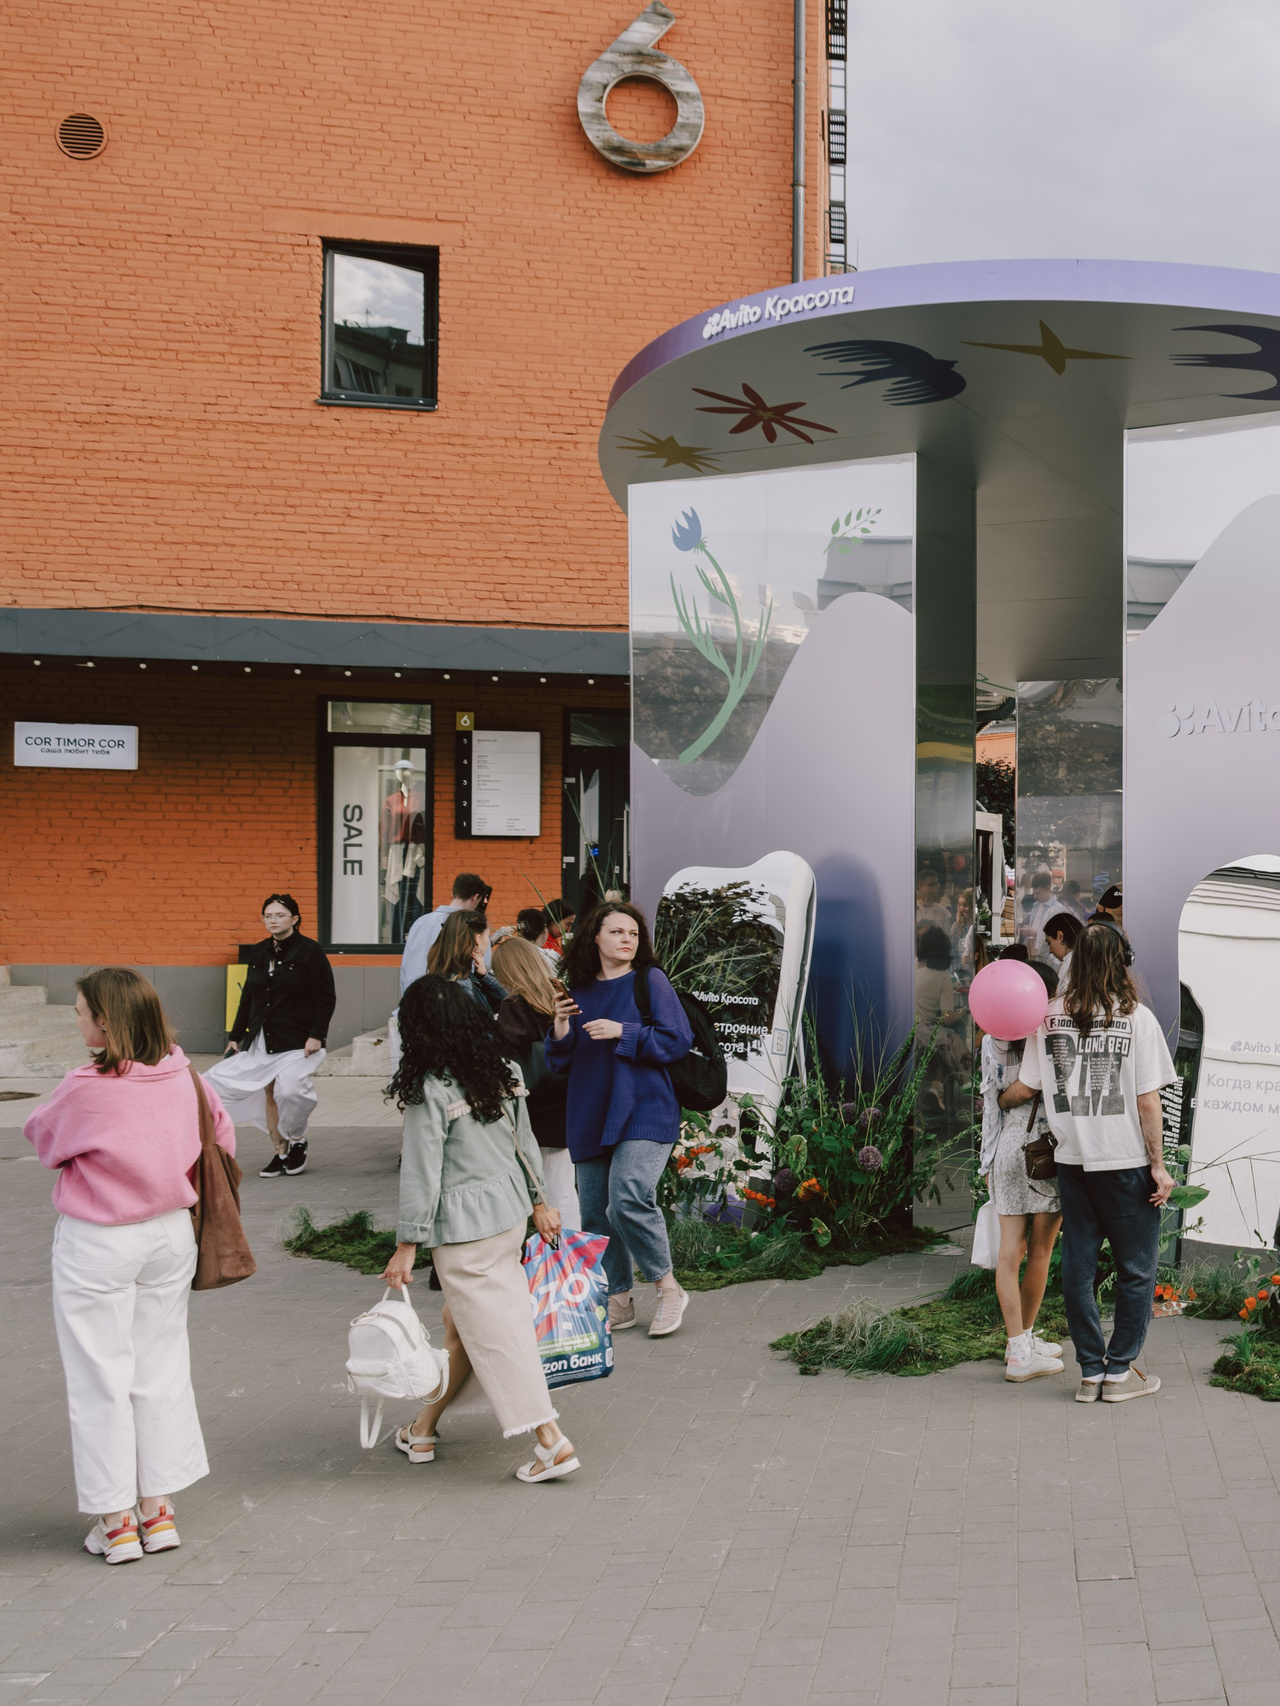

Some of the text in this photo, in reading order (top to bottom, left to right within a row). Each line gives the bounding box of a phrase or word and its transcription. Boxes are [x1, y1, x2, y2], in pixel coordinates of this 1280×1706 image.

[577, 1, 705, 173] 6
[719, 286, 855, 333] Avito Красота
[460, 715, 471, 727] 6
[24, 736, 126, 749] COR TIMOR COR
[342, 803, 363, 876] SALE
[698, 990, 759, 1006] Avito Красота
[713, 1022, 768, 1036] строение
[1078, 1036, 1106, 1053] LONG
[1242, 1040, 1271, 1054] Avito
[1206, 1073, 1251, 1091] Когда
[1203, 1099, 1265, 1114] каждом
[543, 1353, 604, 1374] zon банк
